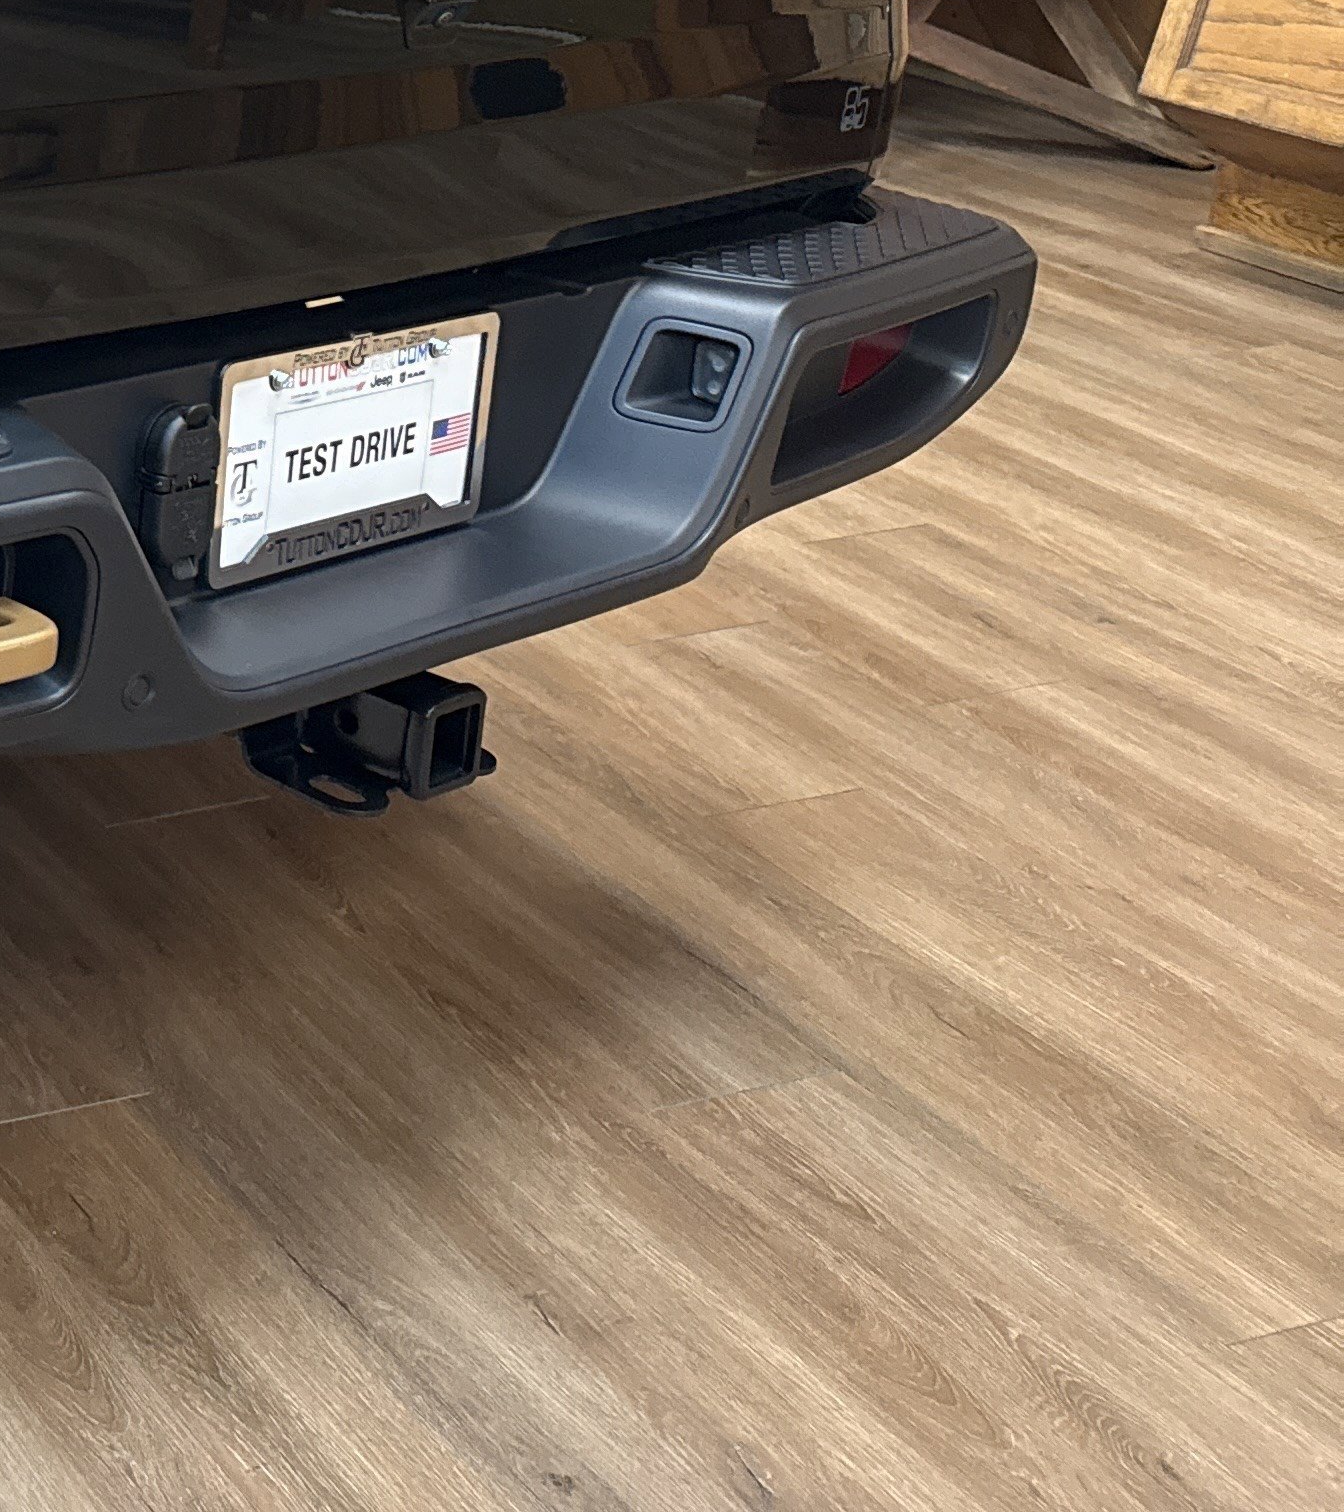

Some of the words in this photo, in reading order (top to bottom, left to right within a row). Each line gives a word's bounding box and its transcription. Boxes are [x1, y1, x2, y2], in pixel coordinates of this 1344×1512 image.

[370, 374, 394, 389] Jeep
[285, 438, 343, 484] TEST
[349, 421, 417, 469] DRIVE
